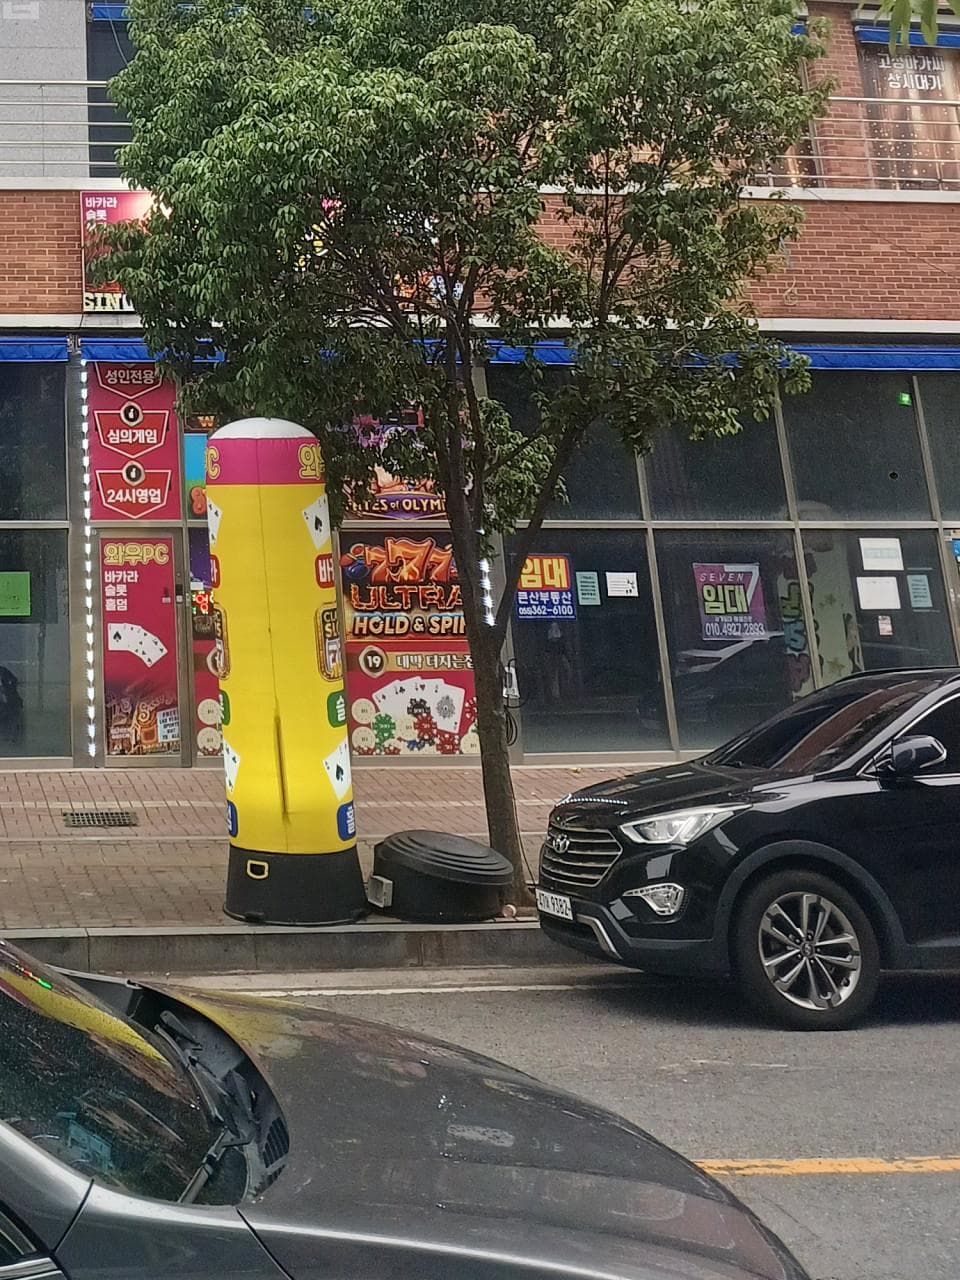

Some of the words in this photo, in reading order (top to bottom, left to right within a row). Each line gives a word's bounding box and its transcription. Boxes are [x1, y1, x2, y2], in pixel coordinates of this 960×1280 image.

[85, 197, 117, 209] 바카라
[105, 369, 156, 385] 성인전용
[107, 428, 158, 444] 심의게임
[106, 489, 162, 504] 24시영업
[103, 543, 169, 565] 와우PC
[104, 571, 139, 584] 바카라
[521, 558, 569, 588] 임대
[700, 572, 745, 582] SEVEN
[105, 585, 128, 597] 슬롯
[350, 584, 462, 611] ULTRA
[518, 592, 572, 605] 큰산부동산
[703, 584, 749, 614] 임대
[353, 611, 410, 636] HOLD
[412, 617, 426, 634] &
[367, 655, 382, 668] 19
